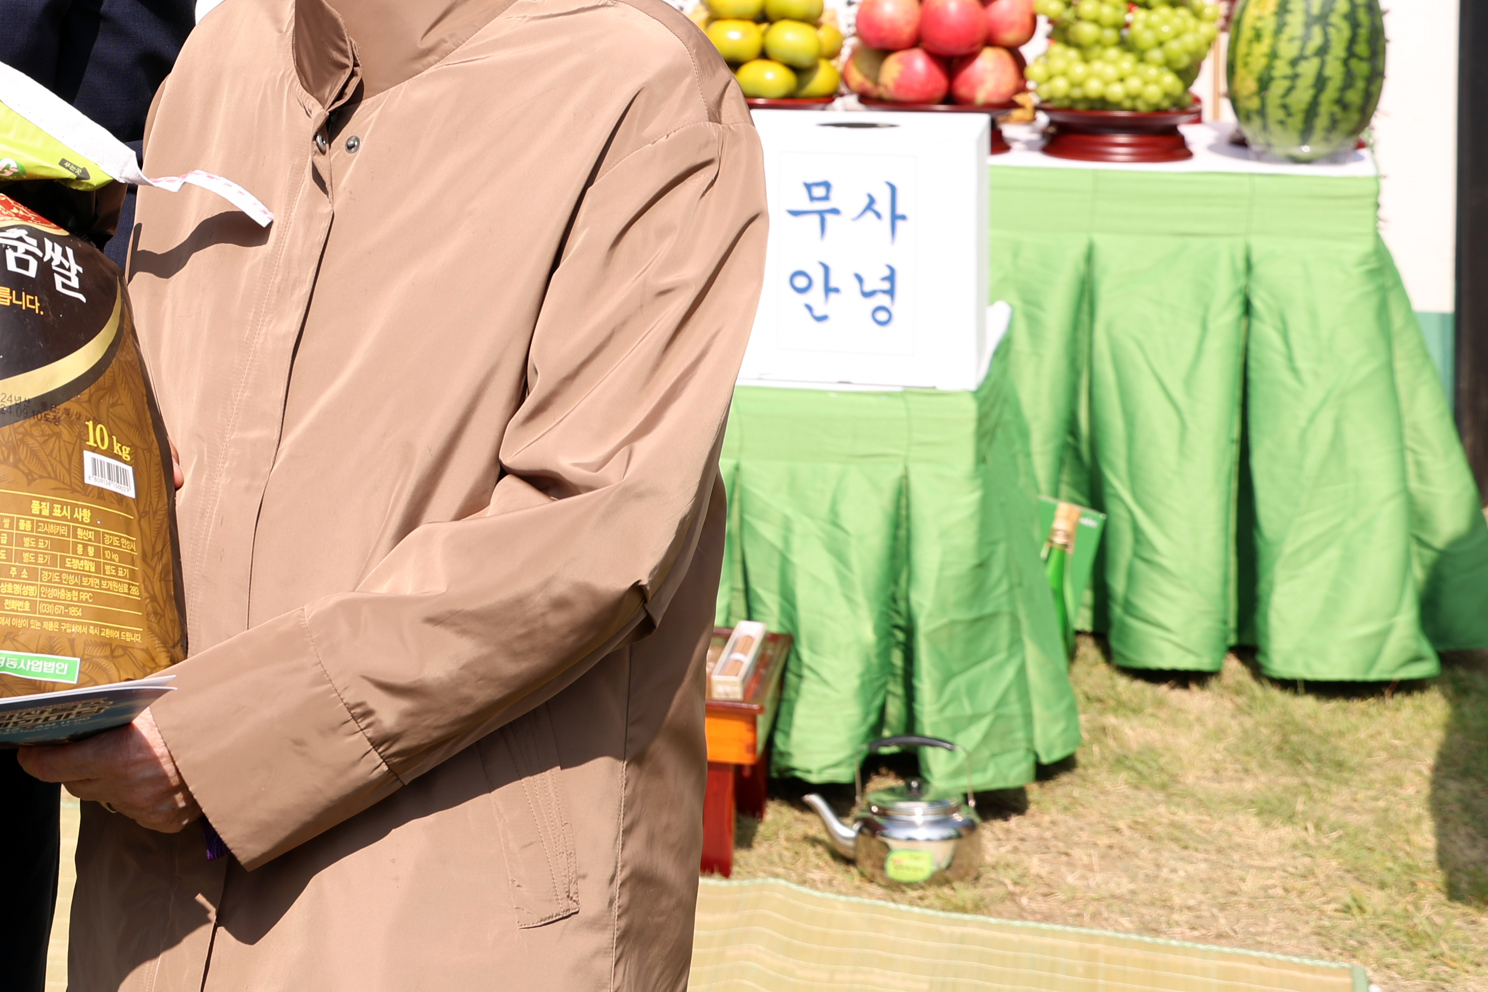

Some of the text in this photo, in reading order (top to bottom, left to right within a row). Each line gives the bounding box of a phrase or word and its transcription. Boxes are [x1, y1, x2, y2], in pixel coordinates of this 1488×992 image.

[785, 179, 909, 246] 무사
[788, 261, 898, 327] 안녕
[85, 421, 131, 462] 10 kg
[30, 500, 91, 524] 품질 표시 사항
[2, 517, 10, 529] 쌀
[18, 519, 32, 531] 품종
[37, 522, 68, 537] 고시히카리
[0, 533, 8, 544] 급
[76, 528, 95, 541] 원산지
[103, 533, 120, 546] 경기도
[23, 537, 51, 550] 별도 표기
[22, 551, 51, 565] 별도 표기
[104, 550, 120, 563] 10 kg
[65, 557, 96, 572] 도정년월일
[104, 564, 130, 578] 별도 표기
[9, 567, 29, 579] 주 소
[41, 571, 61, 583] 경기도
[62, 573, 80, 585] 안성시
[79, 592, 93, 603] RPC
[4, 599, 31, 612] 전화번호
[12, 616, 29, 628] 이상이
[29, 618, 42, 630] 있는
[42, 620, 59, 632] 제품은
[88, 625, 100, 636] 즉시
[100, 627, 120, 640] 교환하여
